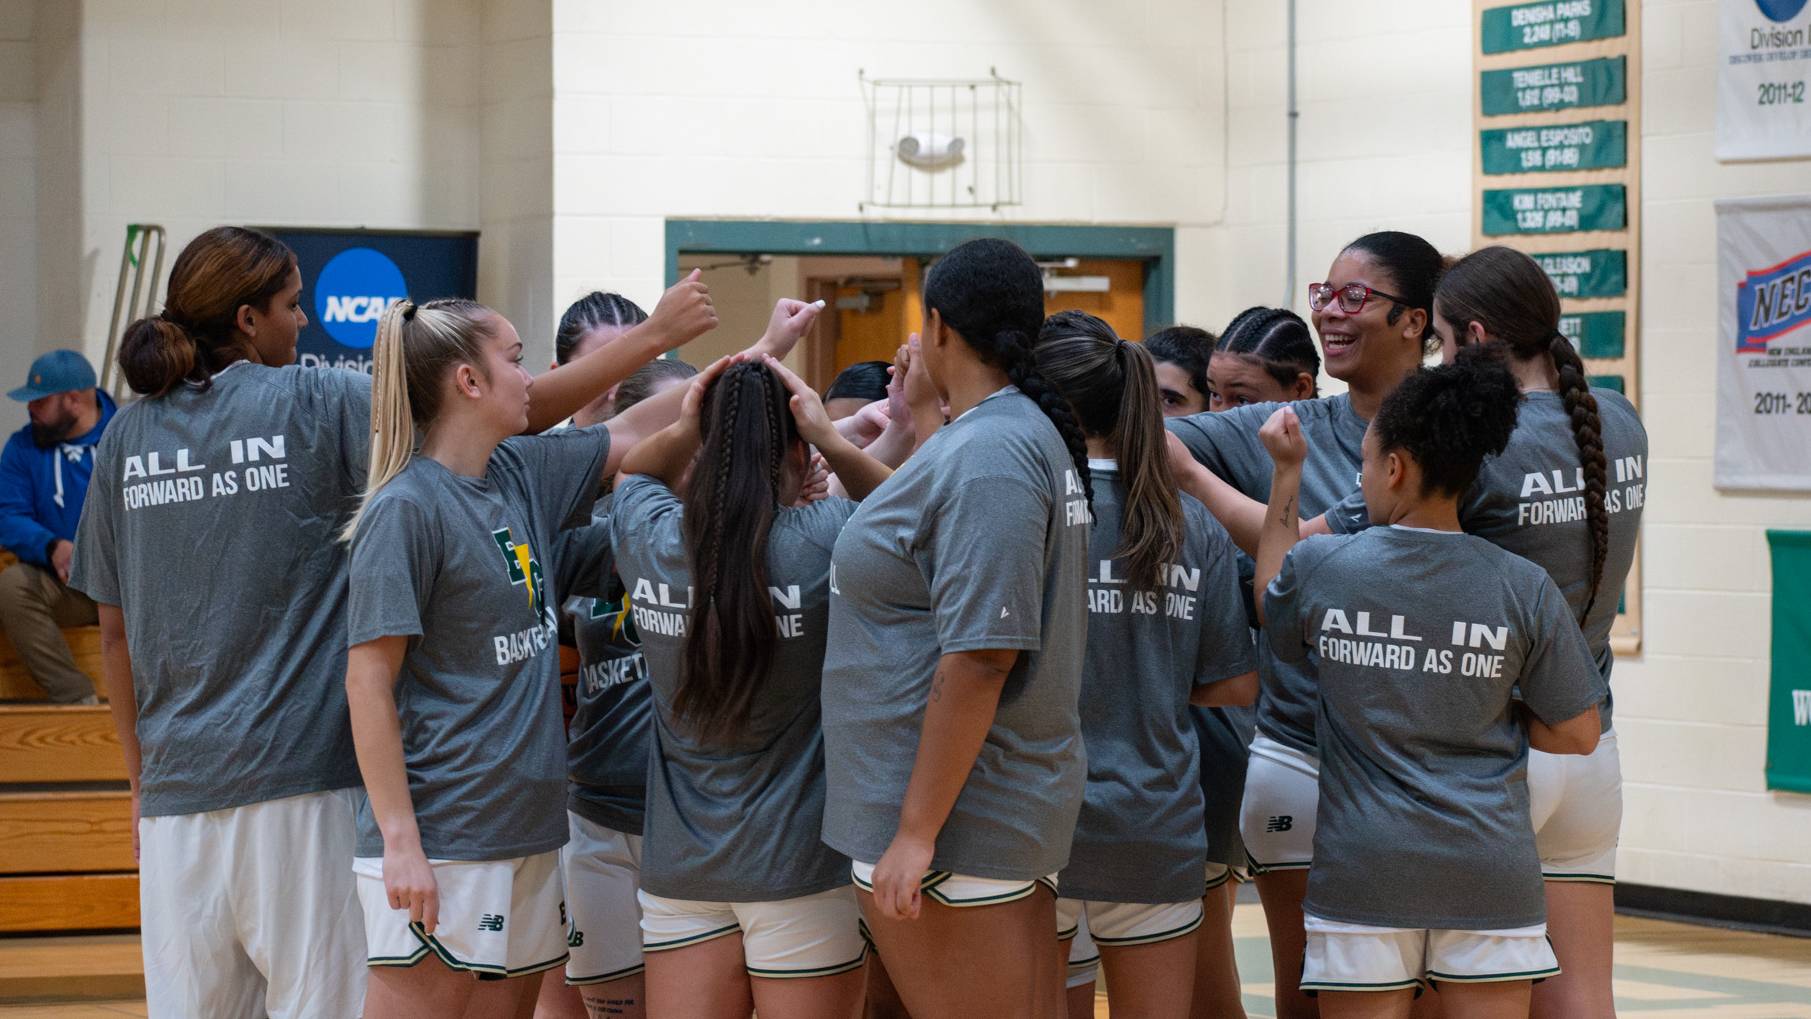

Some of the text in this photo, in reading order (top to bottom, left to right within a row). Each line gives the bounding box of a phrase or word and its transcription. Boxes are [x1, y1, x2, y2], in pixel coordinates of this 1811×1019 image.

[1751, 26, 1804, 50] Division
[1758, 81, 1805, 105] 2011-12
[1505, 130, 1539, 149] ANGEL
[122, 434, 287, 482] ALL IN
[1615, 454, 1643, 483] IN
[123, 463, 290, 512] FORWARD AS ONE
[1517, 484, 1644, 526] FORWAR AS ONE
[767, 584, 801, 609] N
[1131, 590, 1158, 615] AS
[1165, 592, 1197, 621] ONE
[632, 603, 693, 638] FORWA
[775, 613, 805, 639] NE
[1321, 608, 1509, 651] ALL IN
[583, 653, 643, 694] ASKET
[1319, 635, 1505, 679] FORWARD AS ONE
